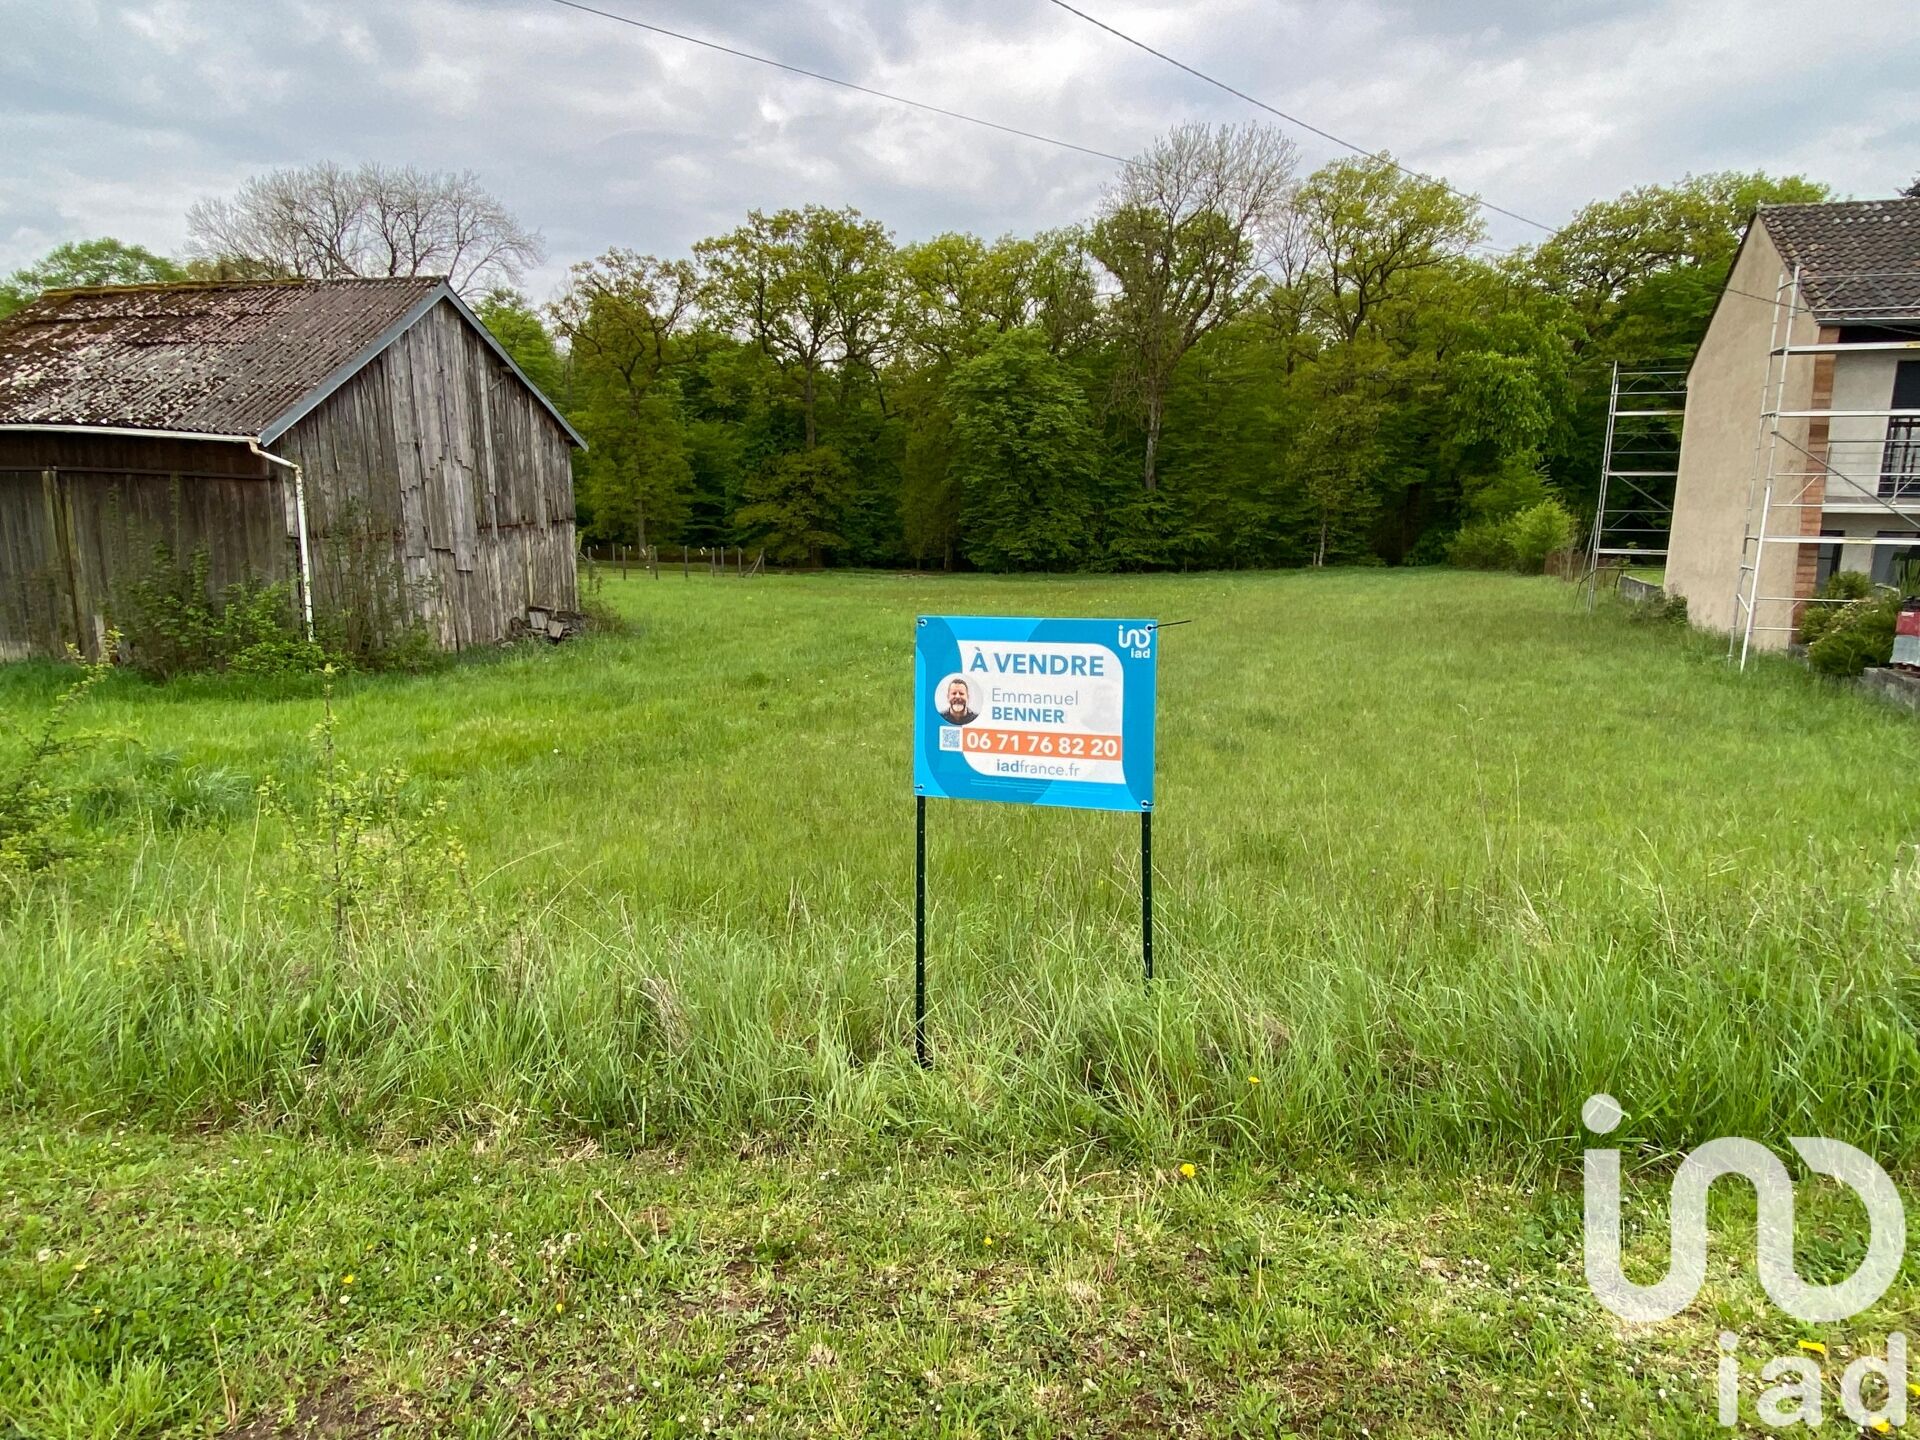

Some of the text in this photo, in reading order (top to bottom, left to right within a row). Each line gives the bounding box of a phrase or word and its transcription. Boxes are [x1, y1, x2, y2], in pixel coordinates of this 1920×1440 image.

[969, 646, 1104, 677] À VENDRE
[1131, 648, 1150, 659] iad
[992, 688, 1079, 706] Emmanuel
[992, 706, 1065, 723] BENNER
[966, 732, 1118, 756] 06 71 76 82 20
[996, 759, 1080, 777] iadfrance.fr
